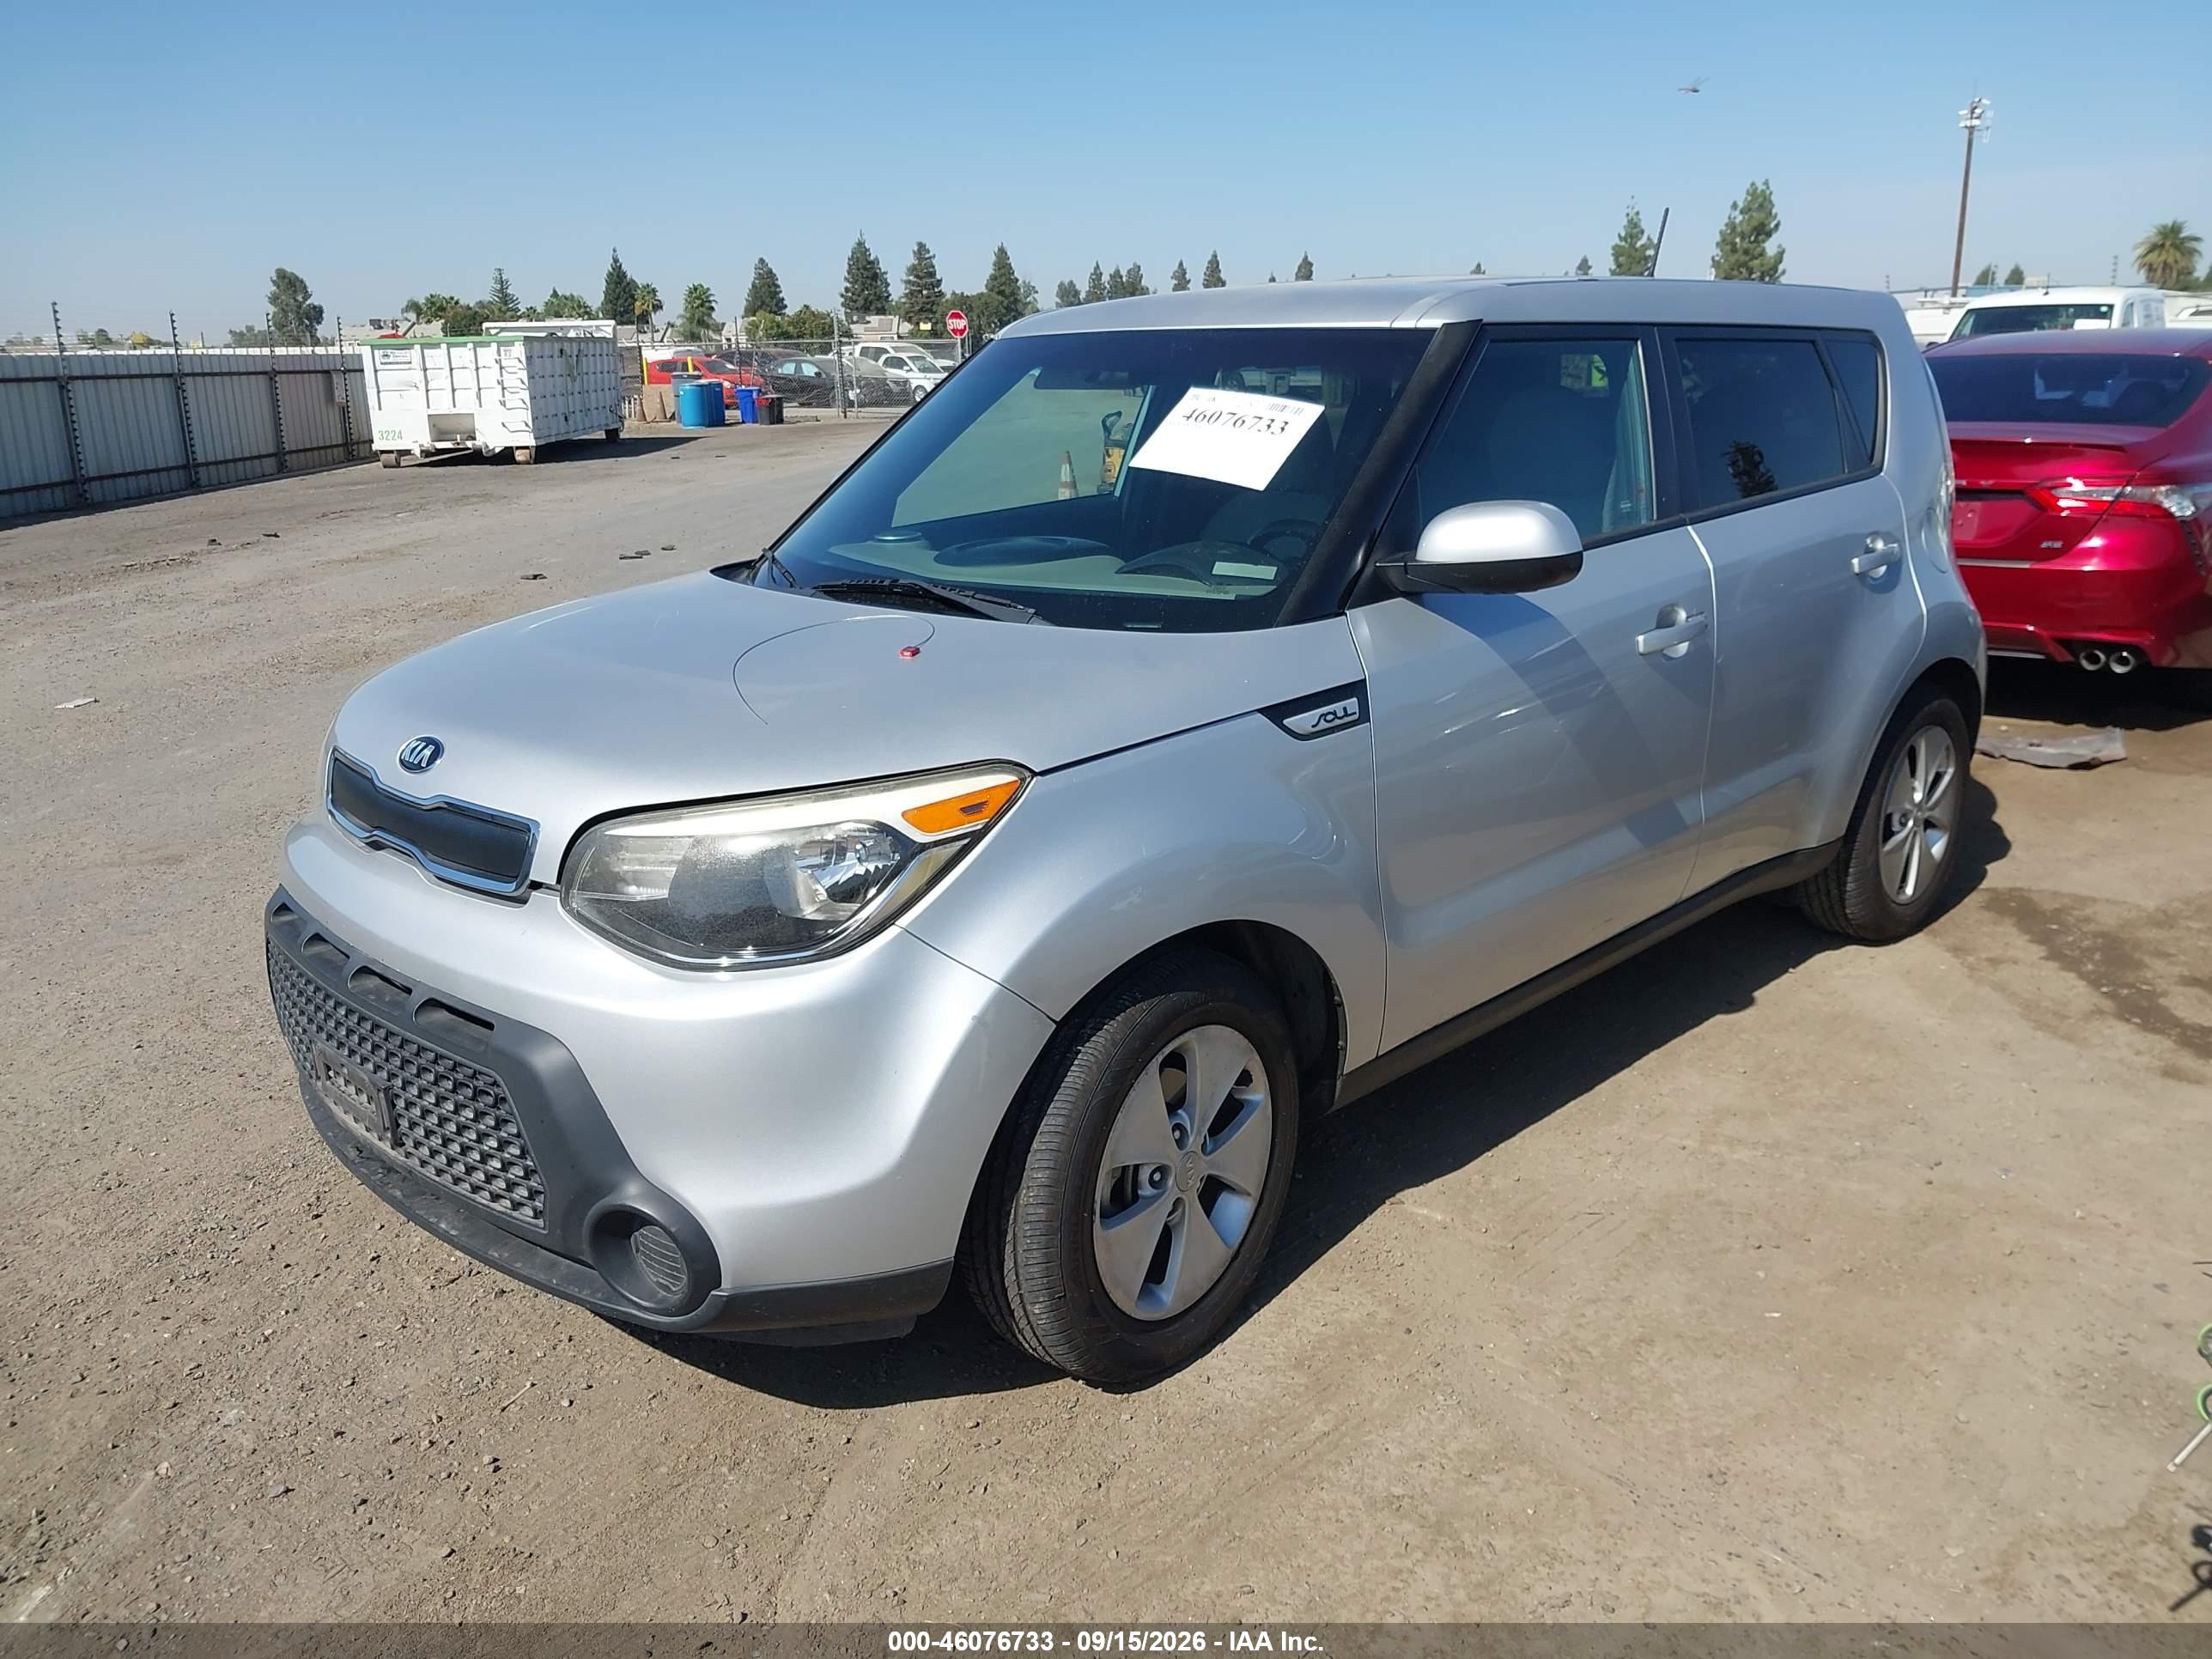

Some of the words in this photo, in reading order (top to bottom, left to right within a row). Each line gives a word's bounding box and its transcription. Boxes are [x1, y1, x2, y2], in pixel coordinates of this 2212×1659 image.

[948, 319, 966, 330] STOP
[1182, 408, 1290, 435] 46076733
[378, 429, 403, 441] 3224
[1311, 707, 1357, 728] SOUL
[401, 739, 435, 768] KIA
